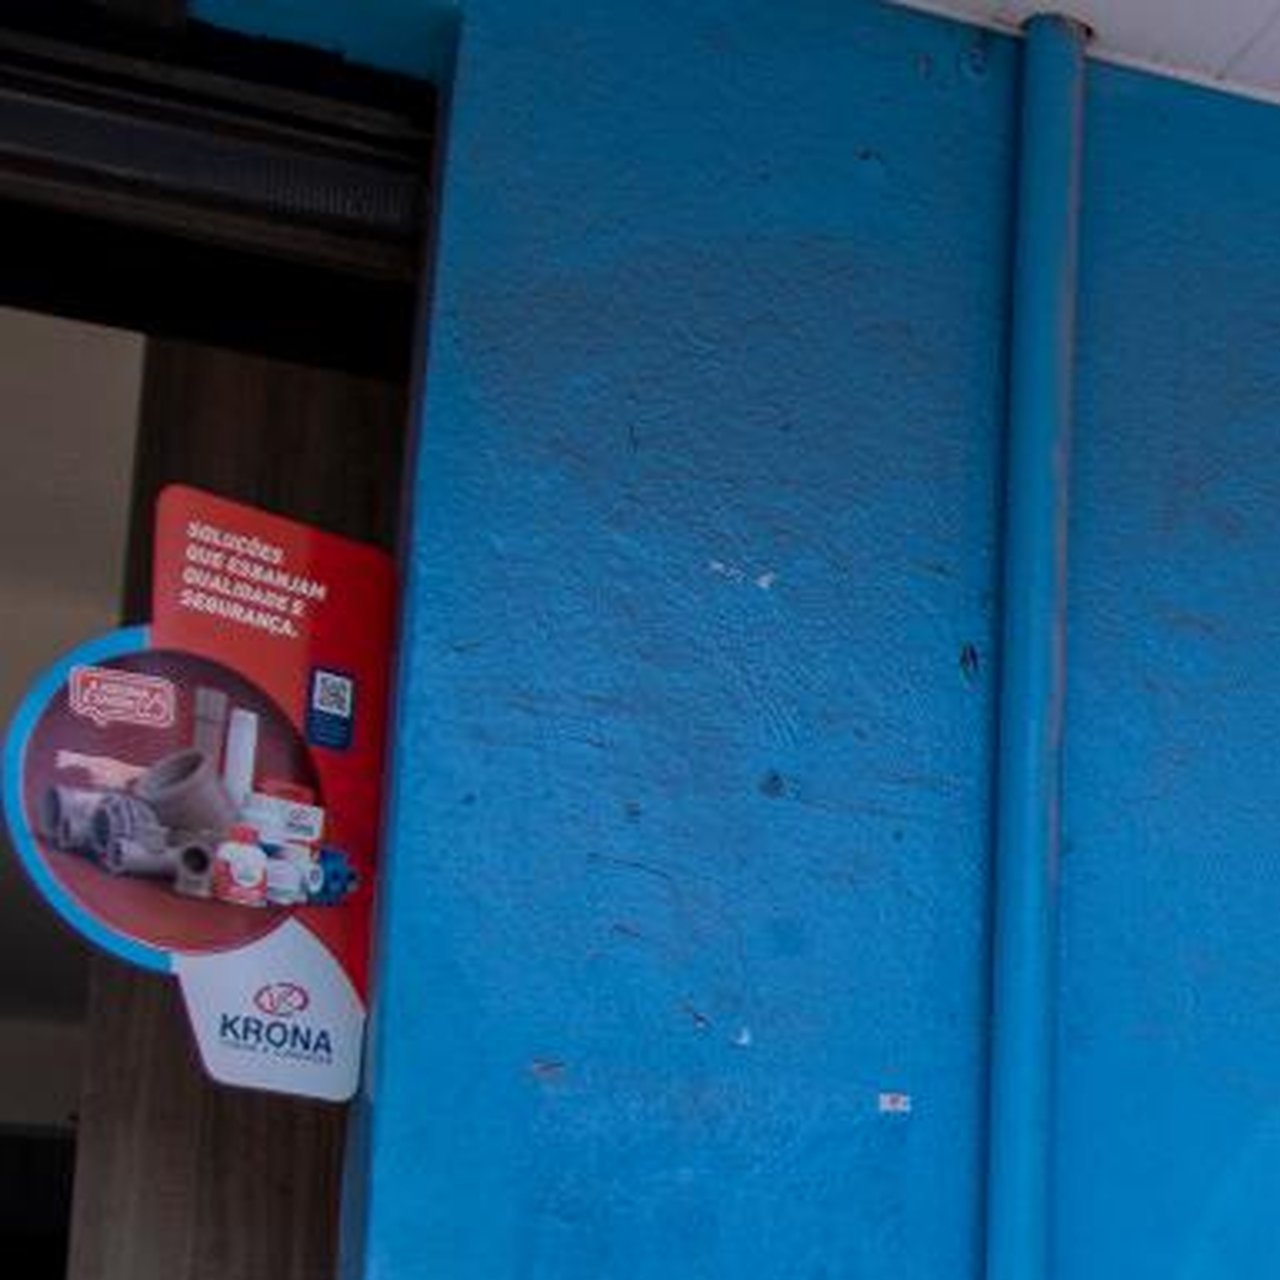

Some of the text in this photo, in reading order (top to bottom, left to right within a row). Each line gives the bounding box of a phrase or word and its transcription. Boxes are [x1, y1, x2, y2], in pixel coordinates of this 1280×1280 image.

[186, 520, 283, 563] SOLUÇÕES
[186, 543, 224, 570] QUE
[182, 566, 303, 616] QUALIDADE E
[179, 588, 299, 638] SEGURANÇA.
[221, 1013, 332, 1054] KRONA
